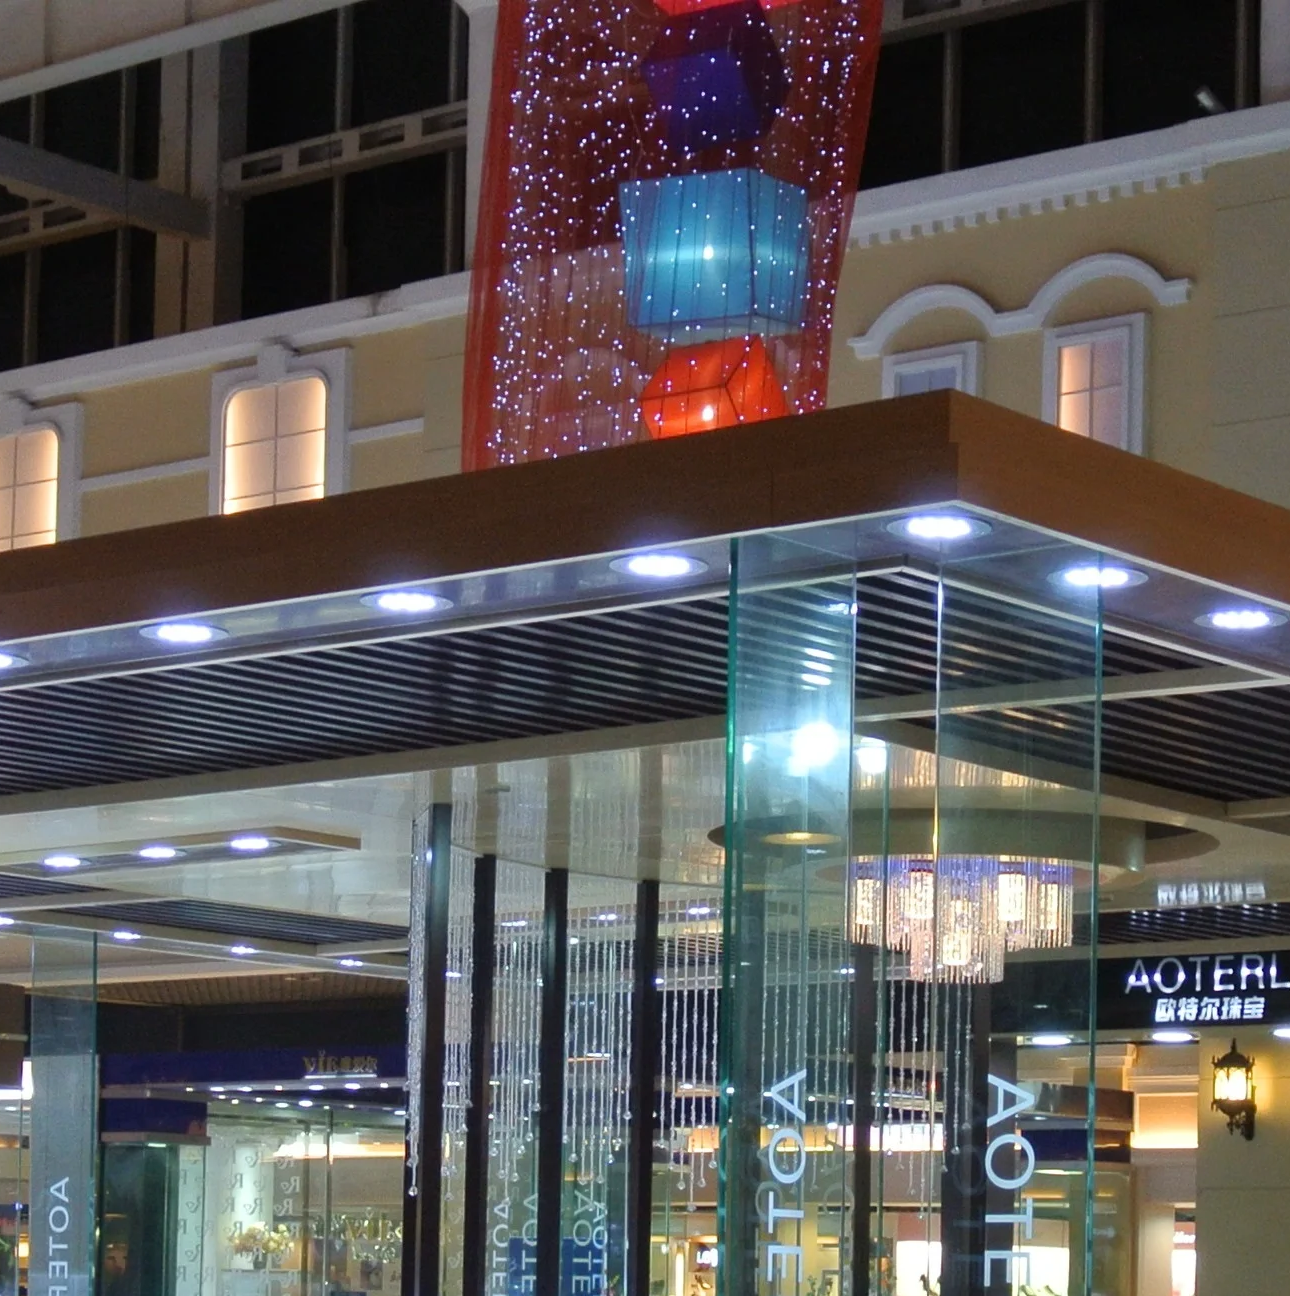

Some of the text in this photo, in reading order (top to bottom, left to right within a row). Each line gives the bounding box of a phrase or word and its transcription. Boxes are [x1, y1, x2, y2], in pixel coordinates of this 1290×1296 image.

[1155, 996, 1265, 1022] 欧特尔珠宝
